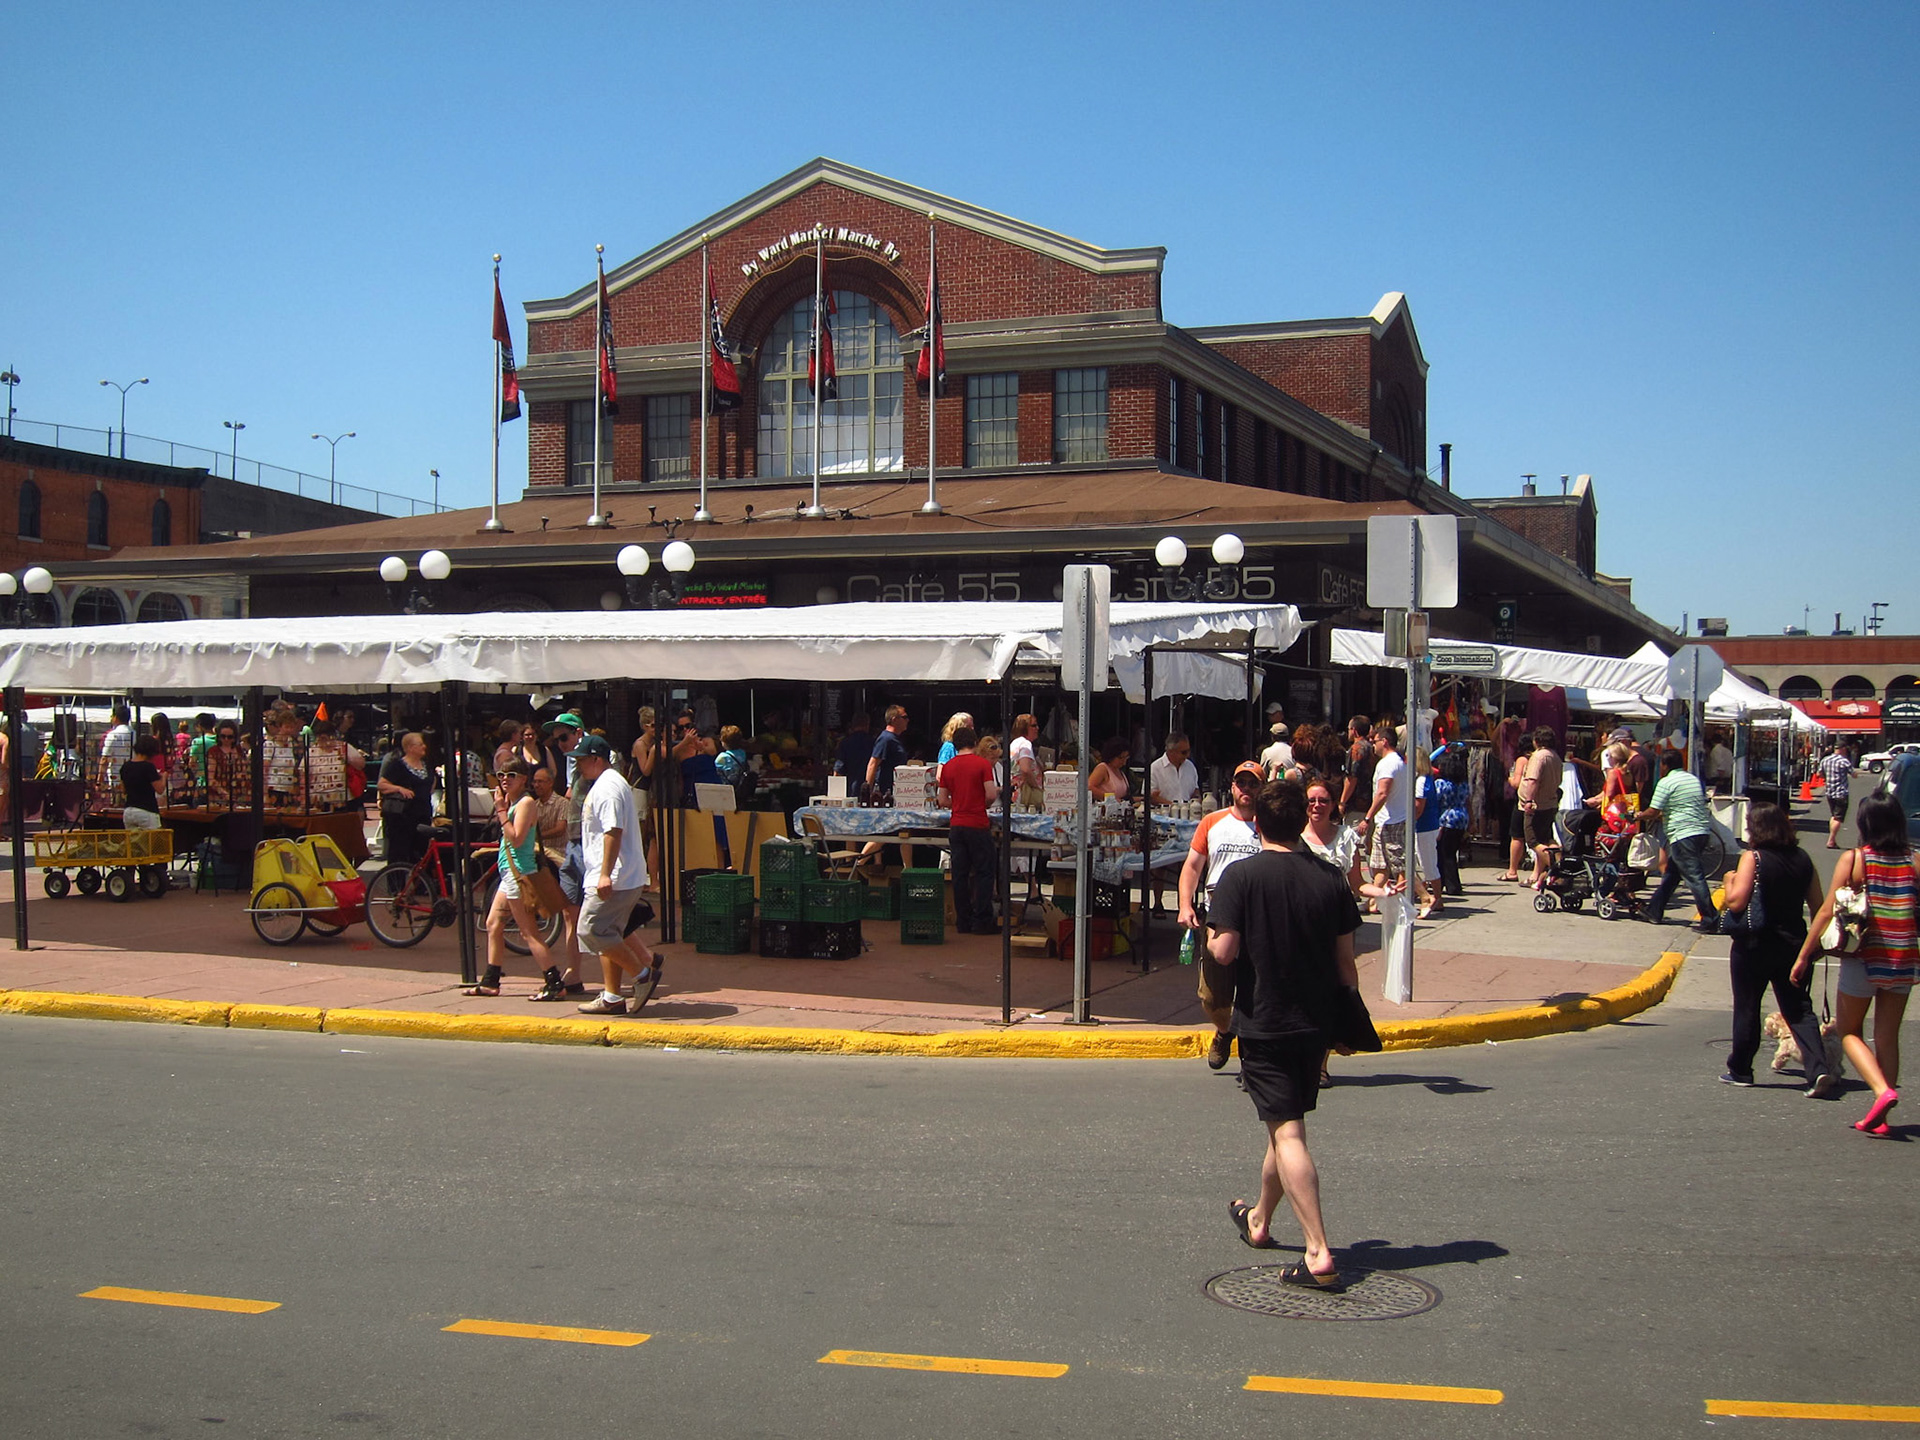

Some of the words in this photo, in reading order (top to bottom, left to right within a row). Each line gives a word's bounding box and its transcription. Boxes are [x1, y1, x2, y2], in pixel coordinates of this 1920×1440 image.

[741, 260, 759, 276] By
[758, 237, 789, 261] Ward
[789, 227, 834, 246] Market
[884, 241, 901, 261] By
[677, 594, 767, 605] NTRANCE/ENTRÉE
[847, 573, 945, 602] Café
[958, 572, 1020, 602] 55
[1207, 565, 1276, 600] 55
[1321, 568, 1348, 604] Café
[1350, 578, 1366, 611] 55
